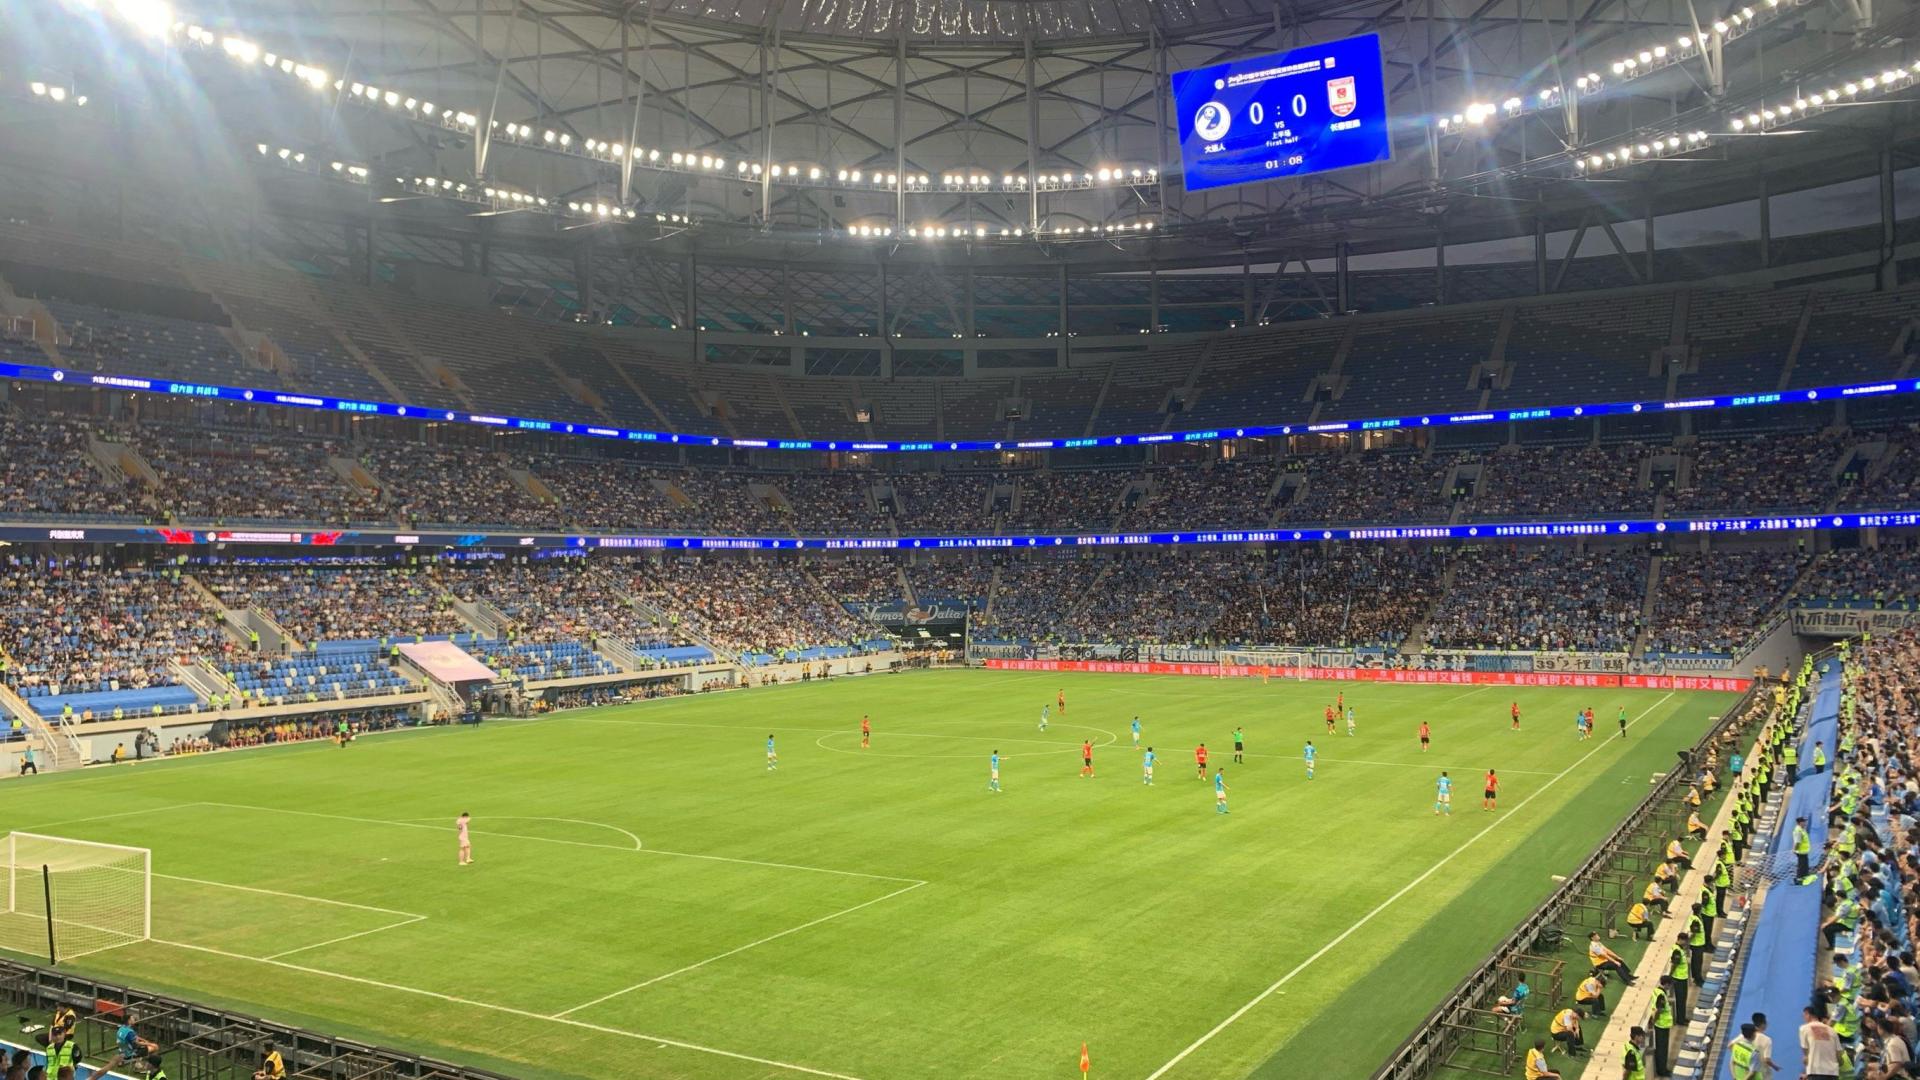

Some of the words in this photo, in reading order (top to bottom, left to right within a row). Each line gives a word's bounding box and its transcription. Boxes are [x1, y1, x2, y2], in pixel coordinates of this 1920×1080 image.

[1249, 101, 1264, 125] 0
[1292, 94, 1307, 117] 0
[1274, 121, 1285, 129] VS
[1265, 138, 1283, 148] first
[1284, 136, 1299, 146] half
[1308, 653, 1355, 668] NORD
[1536, 660, 1555, 669] 39
